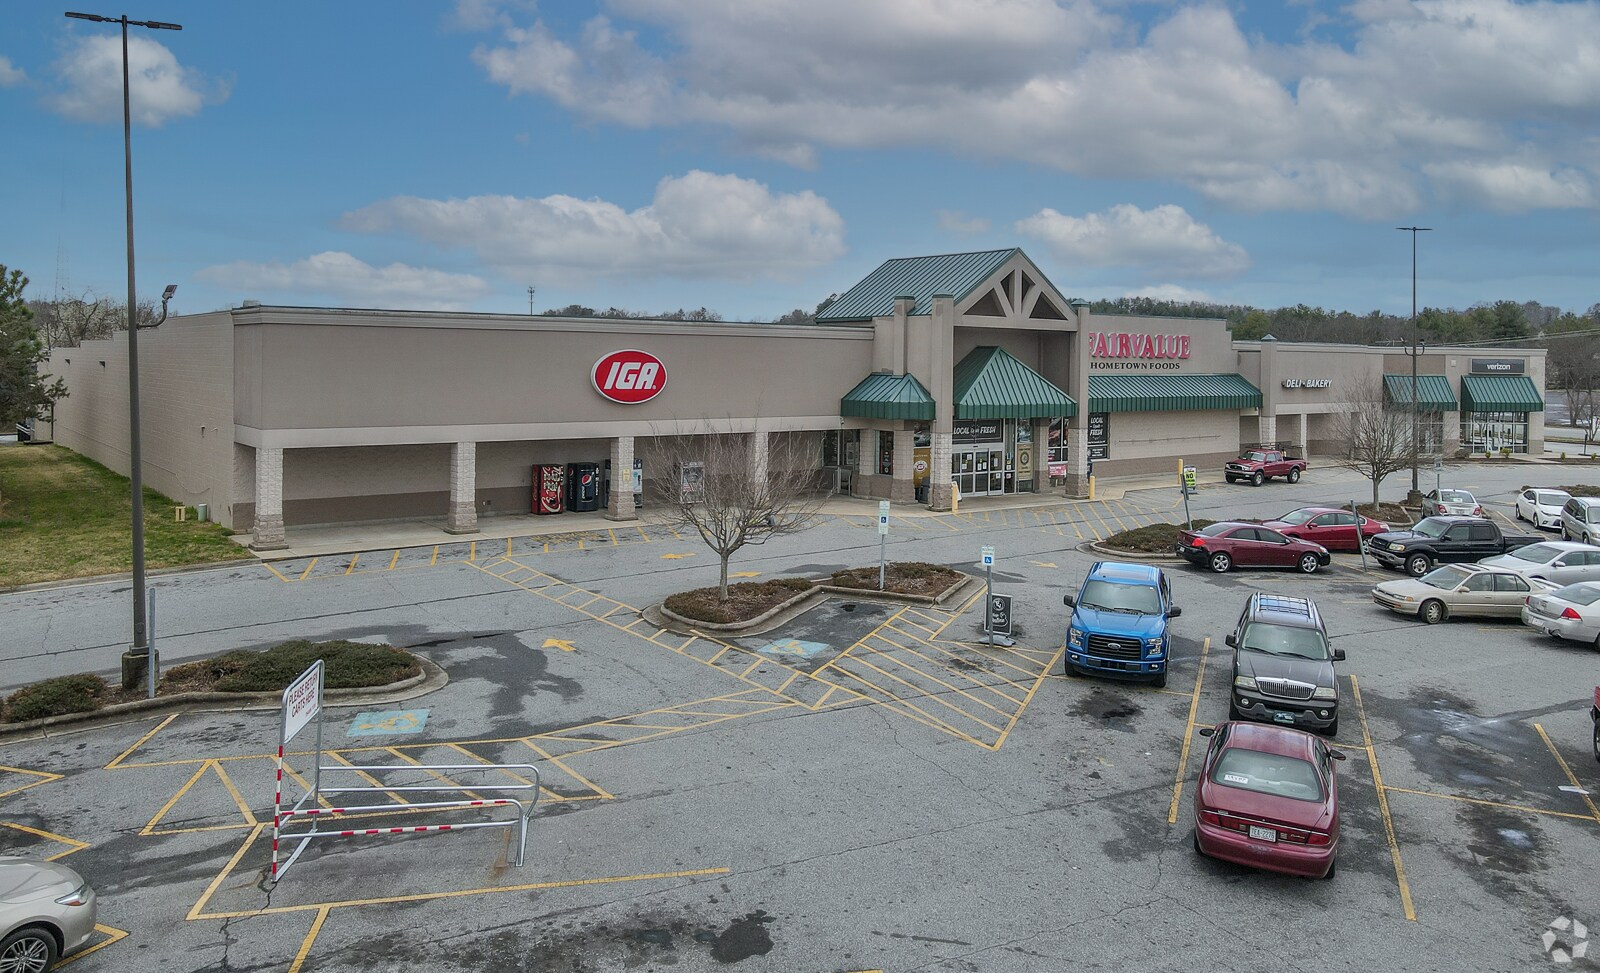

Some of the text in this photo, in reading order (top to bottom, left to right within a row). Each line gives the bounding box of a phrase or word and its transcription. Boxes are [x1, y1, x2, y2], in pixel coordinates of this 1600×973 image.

[1088, 332, 1191, 359] FAIRVALUE
[1090, 362, 1180, 370] HOMETOWN FOODS
[1486, 362, 1511, 370] verizon
[604, 361, 659, 390] IGA
[1285, 379, 1302, 388] DELI
[1306, 379, 1333, 388] BAKERY
[1090, 416, 1104, 424] LOCAL
[953, 426, 970, 435] LOCAL
[980, 425, 997, 435] FRESH
[1090, 428, 1103, 436] FRESH
[288, 683, 305, 707] PLEASE
[292, 697, 306, 718] CARTS
[306, 687, 315, 704] HERE
